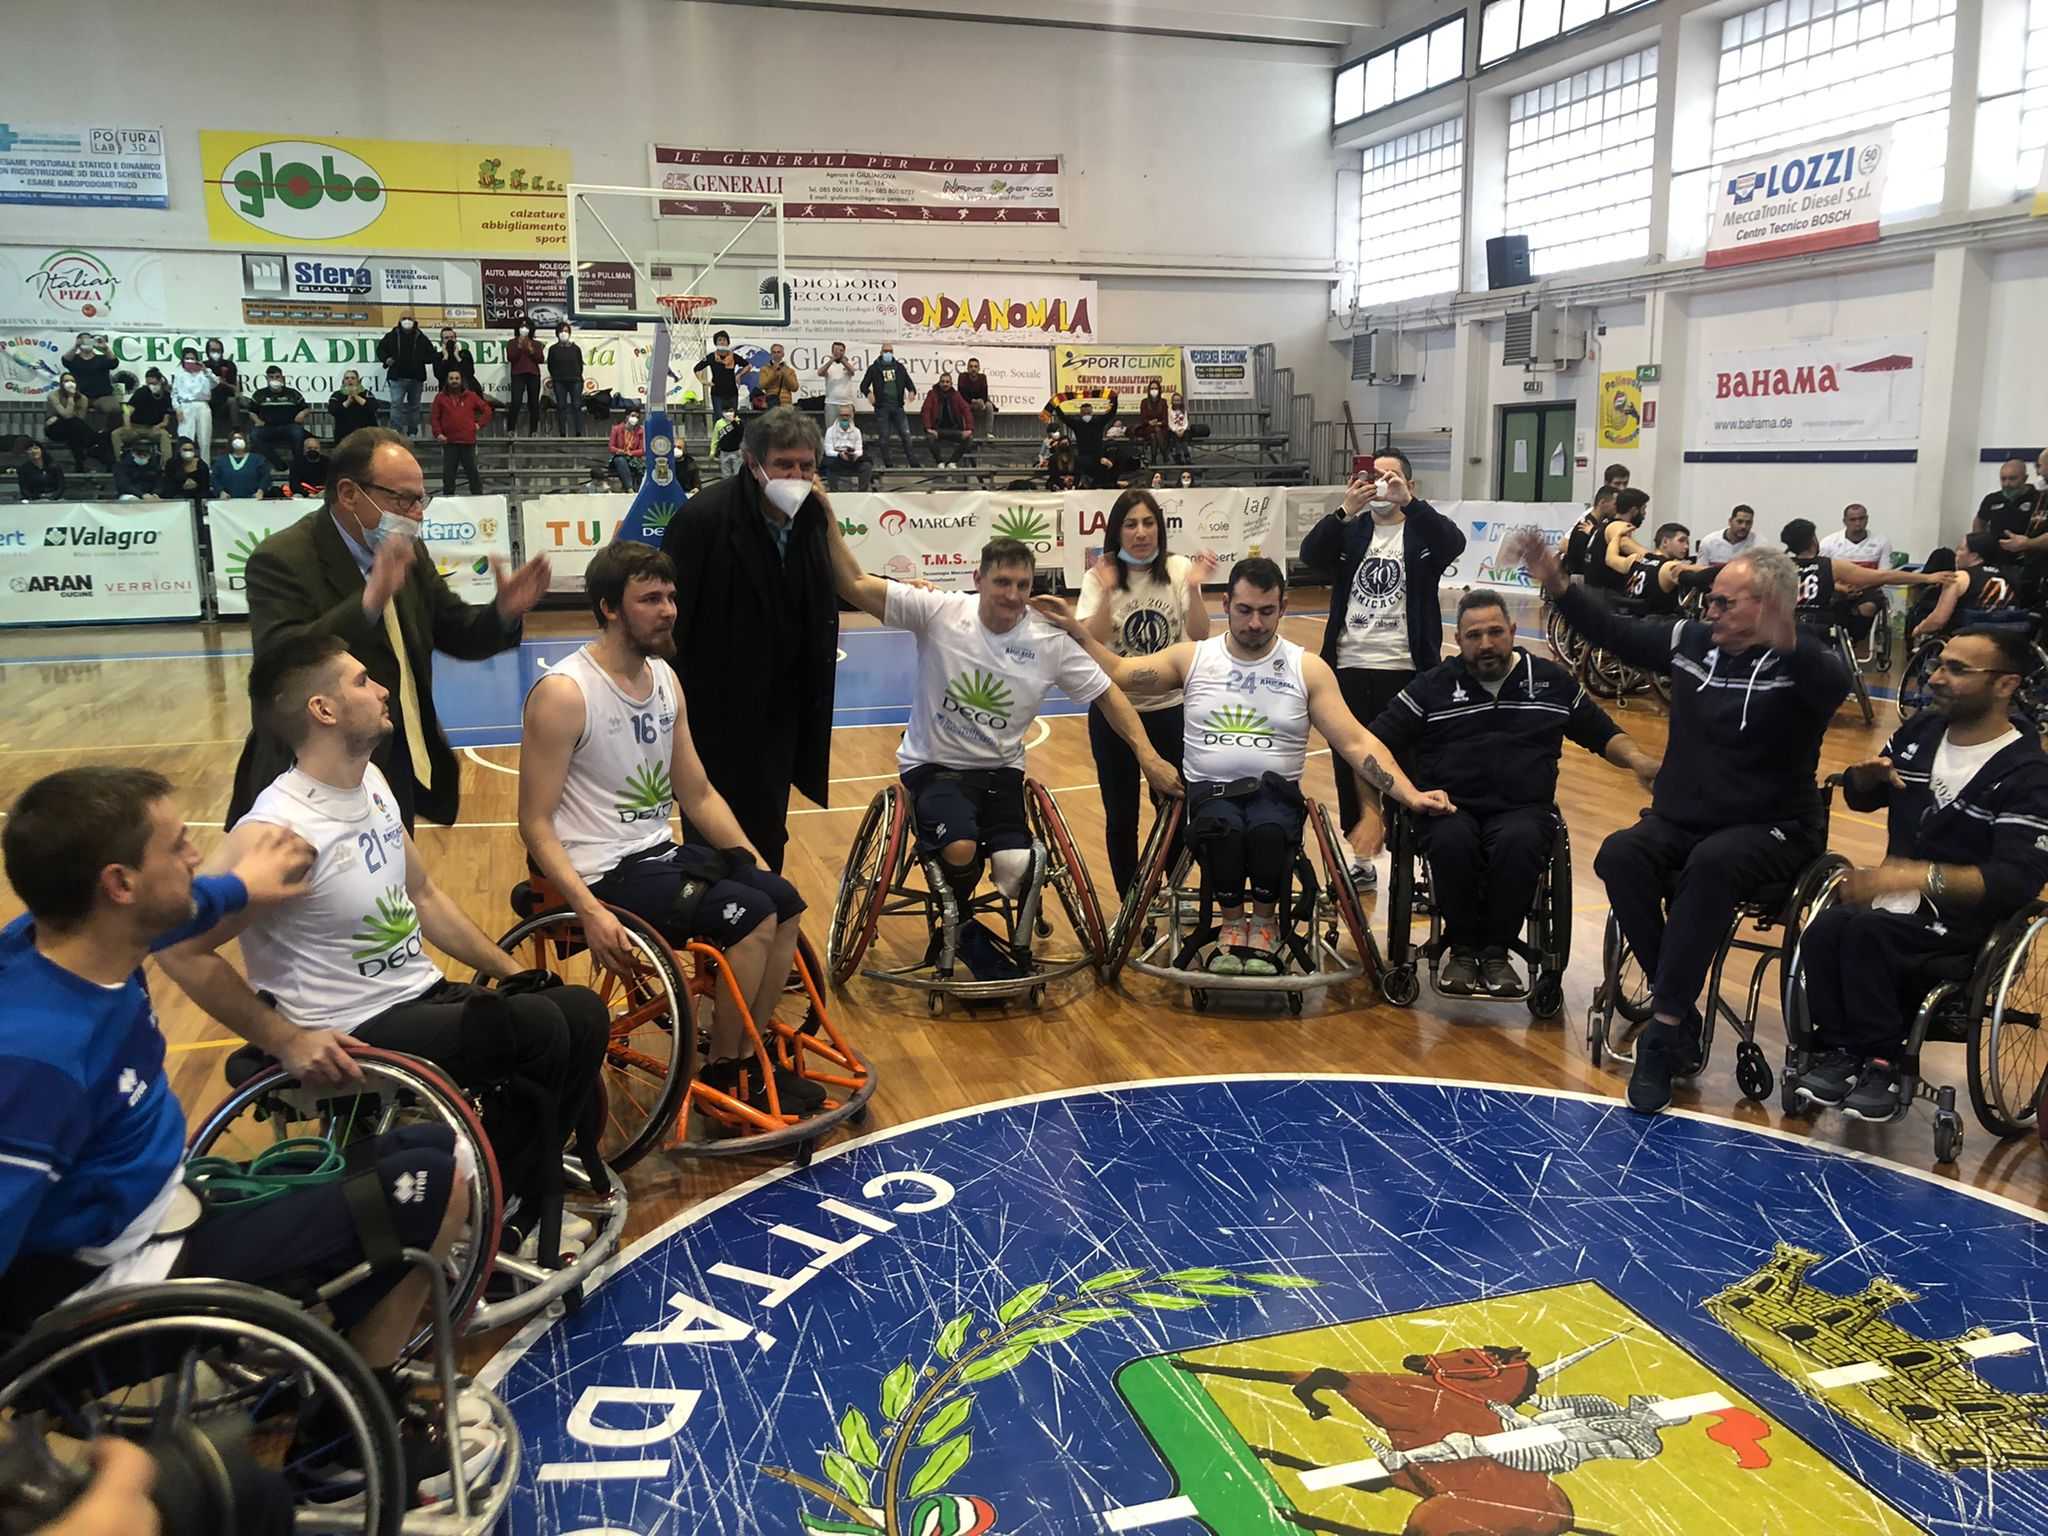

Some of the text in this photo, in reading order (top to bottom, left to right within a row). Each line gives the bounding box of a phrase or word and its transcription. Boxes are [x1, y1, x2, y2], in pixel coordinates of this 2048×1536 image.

[132, 144, 147, 153] 3D
[79, 161, 112, 169] STATICO
[121, 162, 161, 171] DINAMICO
[675, 151, 1045, 173] LE GENERALI PER LO SPORT
[1766, 146, 1856, 198] LOZZI
[234, 151, 381, 218] globo
[693, 174, 784, 194] GENERALI
[1801, 192, 1843, 212] Diesel
[510, 209, 567, 219] calzature
[481, 220, 567, 232] abbigliamento
[1736, 209, 1852, 241] Centro Tecnico BOSCH
[535, 234, 567, 245] sport
[294, 261, 372, 286] Sfera
[485, 269, 507, 278] AUTO,
[598, 272, 631, 280] PULLMAN
[25, 267, 121, 299] Italian
[298, 286, 367, 294] QUALITY
[794, 278, 897, 290] DIODORO
[59, 289, 102, 301] PIZZA
[794, 291, 896, 303] ECOLOGIA
[901, 292, 1092, 334] ONDAANOMALA
[261, 336, 318, 364] LA
[1010, 368, 1041, 379] Sociale
[1077, 375, 1107, 384] CENTRO
[988, 392, 1036, 405] mprese
[1713, 416, 1793, 431] www.bahama.de
[70, 526, 158, 550] Valagro
[922, 552, 967, 566] T.M.S.
[28, 575, 93, 592] ARAN
[1368, 566, 1391, 585] 40
[1225, 669, 1257, 695] 24
[943, 696, 1008, 730] DECO
[630, 712, 658, 745] 16
[1203, 733, 1273, 749] DECO
[358, 828, 388, 874] 21
[536, 1384, 703, 1483] DI
